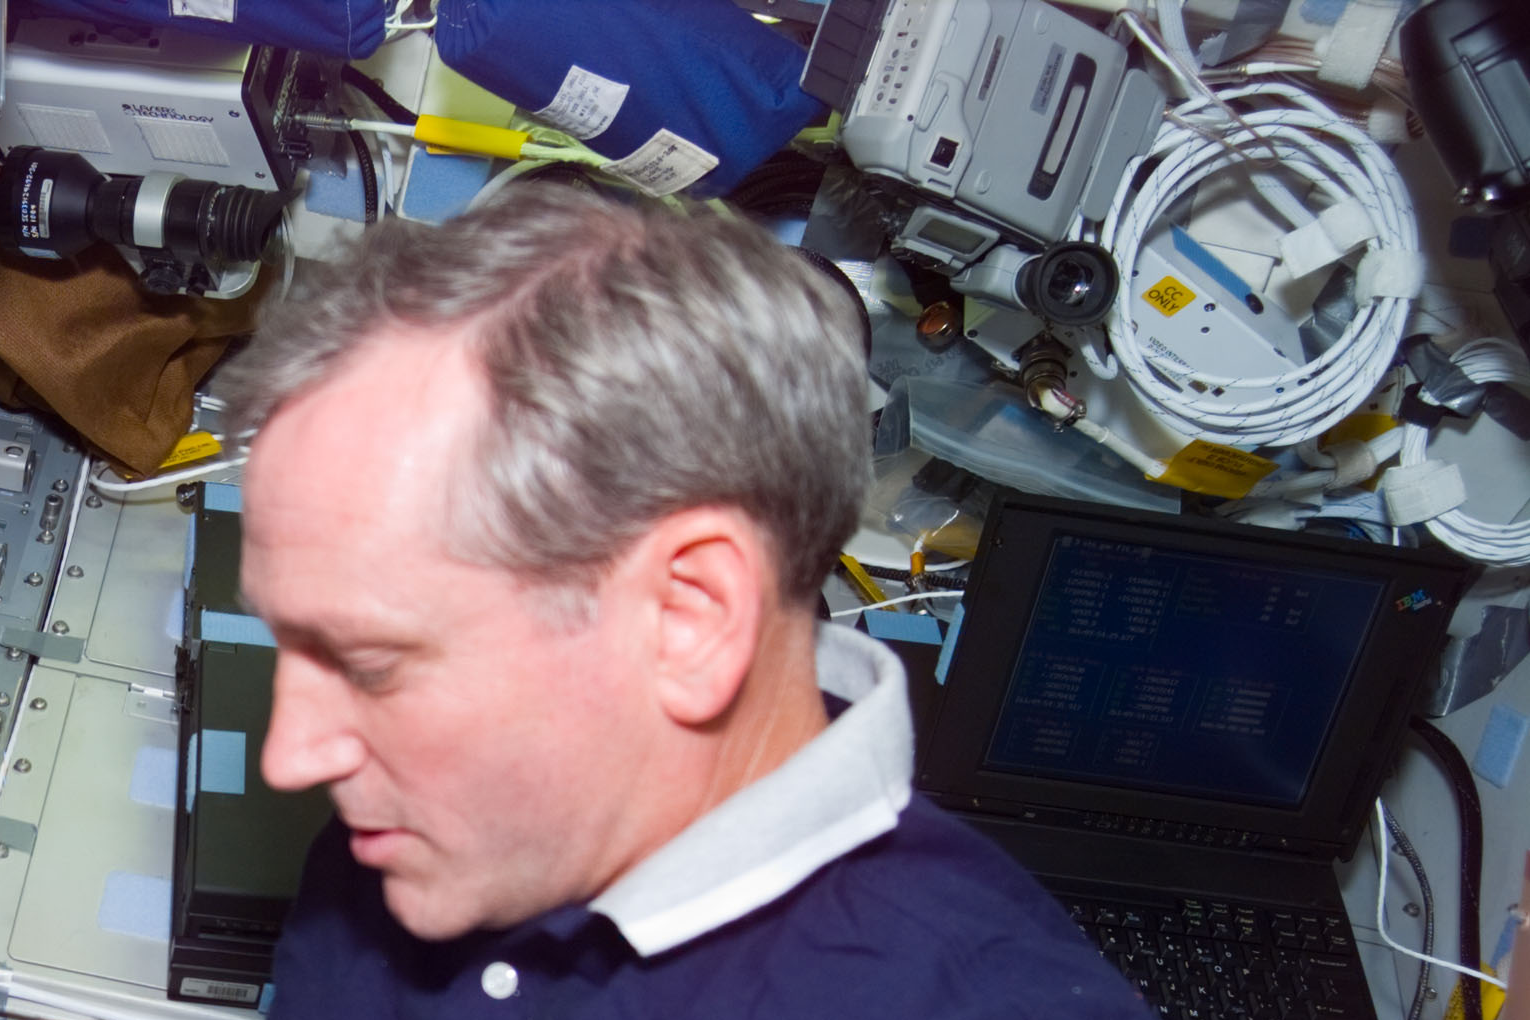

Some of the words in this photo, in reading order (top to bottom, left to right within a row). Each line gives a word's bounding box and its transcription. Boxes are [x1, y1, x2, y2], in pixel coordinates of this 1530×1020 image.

[137, 111, 215, 123] TECHNOLOGY
[1148, 289, 1179, 312] ONLY
[1164, 286, 1183, 300] CC
[1149, 336, 1167, 352] VIDEO
[1395, 588, 1426, 611] IBM
